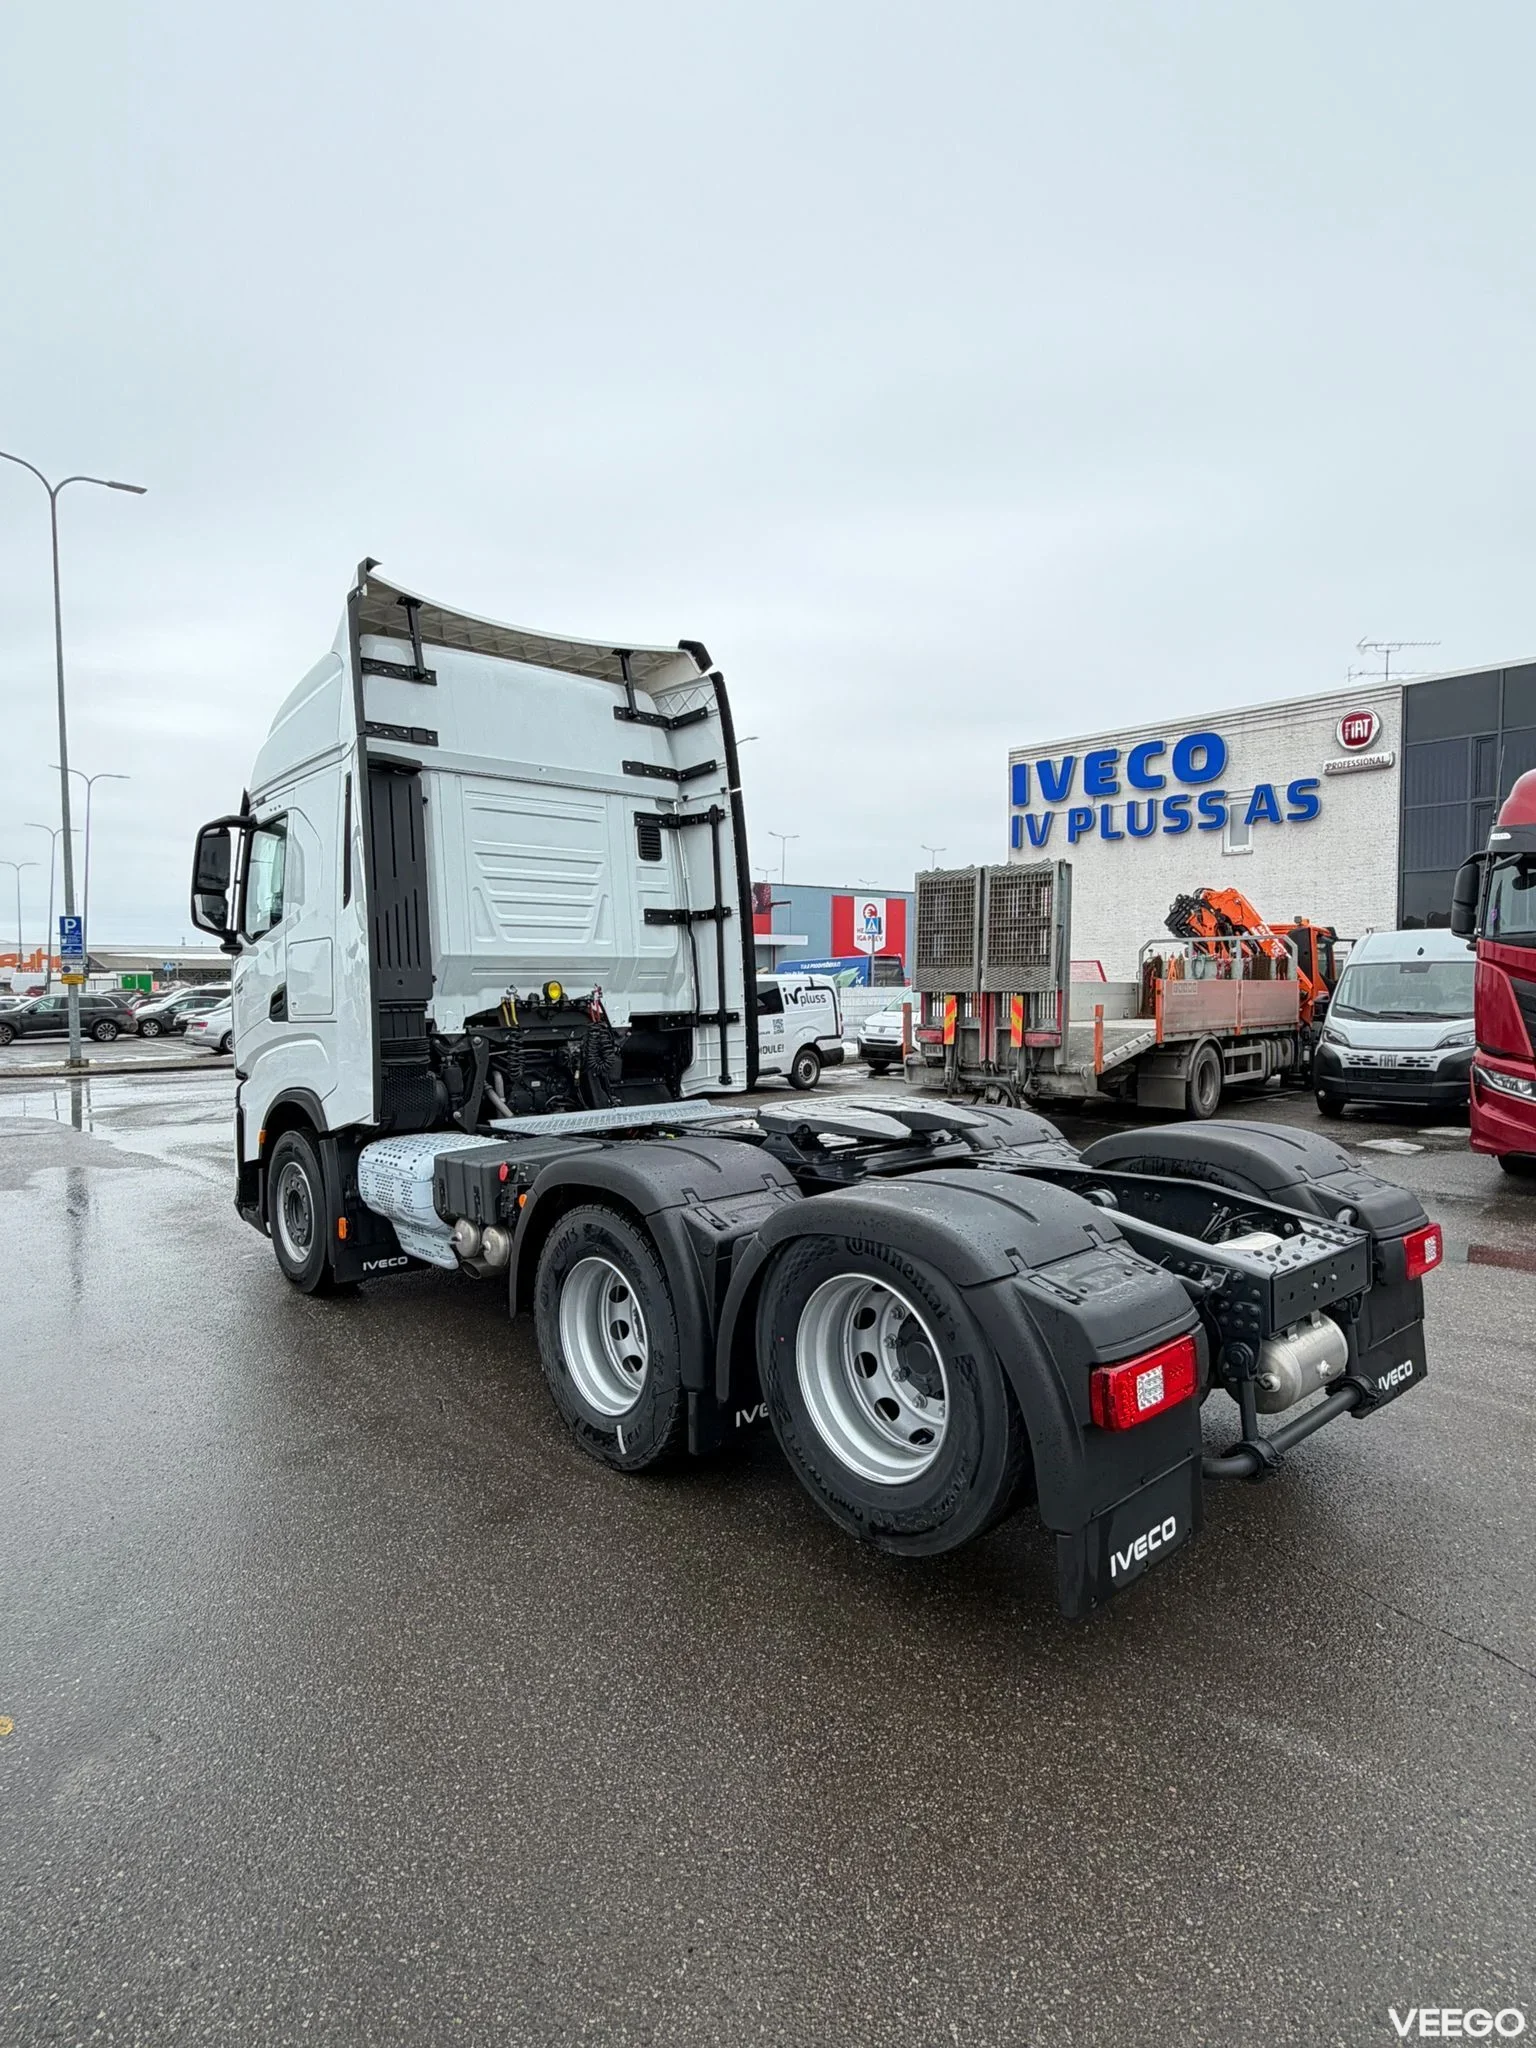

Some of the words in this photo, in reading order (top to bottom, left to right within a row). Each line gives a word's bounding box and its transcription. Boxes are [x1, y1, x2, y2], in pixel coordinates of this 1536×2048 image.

[1345, 718, 1371, 740] FIAT
[1011, 731, 1228, 807] IVECO
[1325, 755, 1385, 771] PROFESSIONAL
[1011, 811, 1054, 849] IV
[1067, 788, 1230, 844] PLUSS
[1244, 777, 1321, 826] AS
[64, 918, 77, 934] P
[1379, 1054, 1399, 1069] FIAT
[362, 1256, 408, 1271] IVECO
[1378, 1359, 1414, 1390] IVECO
[735, 1402, 770, 1428] IVE
[1110, 1515, 1177, 1578] IVECO
